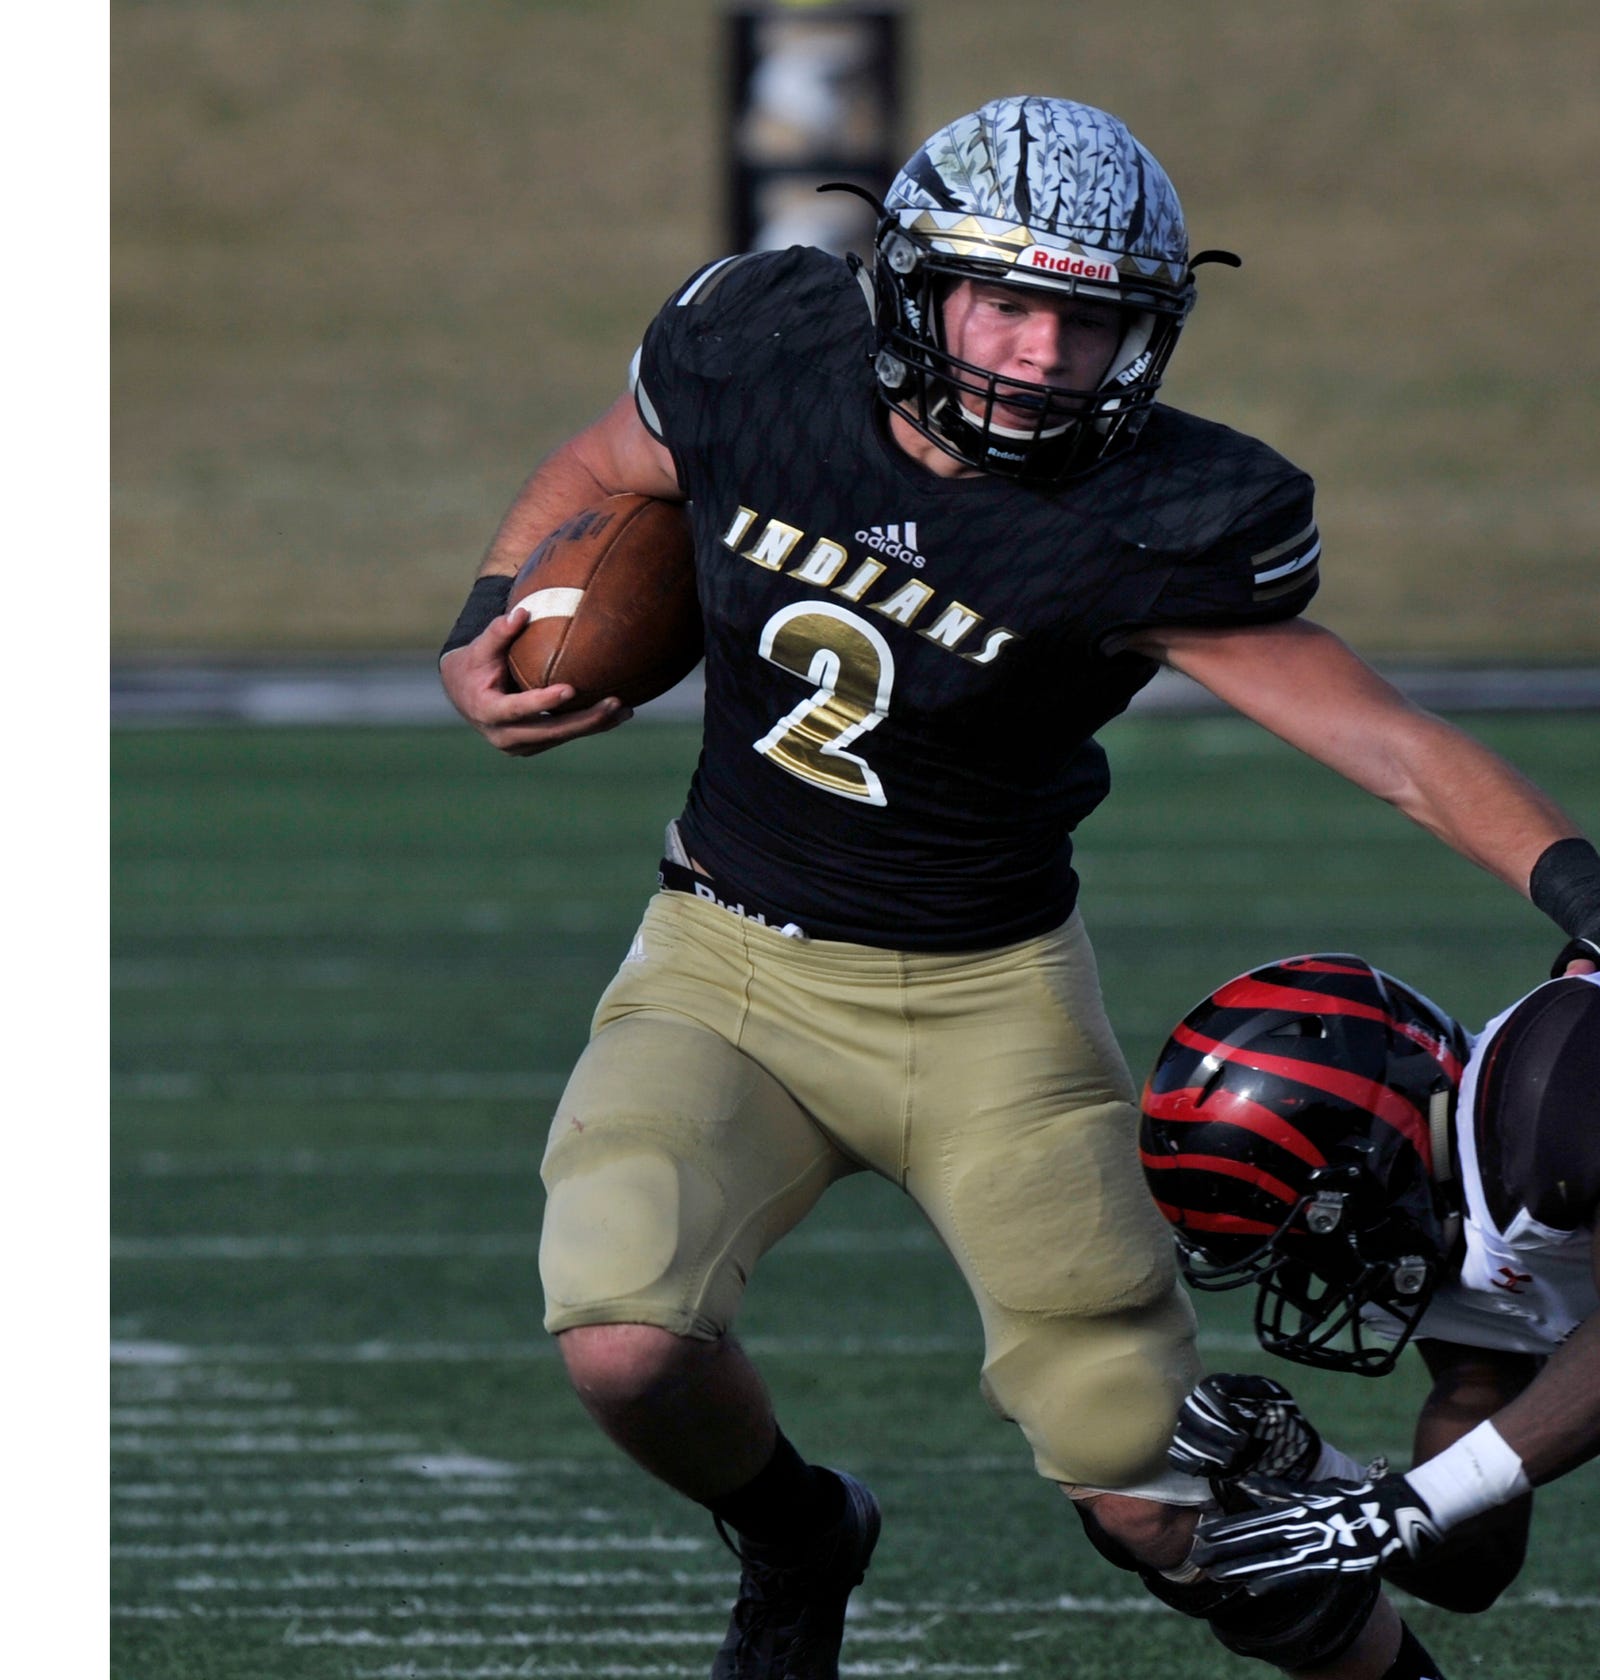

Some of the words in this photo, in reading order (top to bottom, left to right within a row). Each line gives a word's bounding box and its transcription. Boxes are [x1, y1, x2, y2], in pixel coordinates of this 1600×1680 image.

[1032, 250, 1112, 280] Riddell
[719, 505, 1024, 667] INDIANS
[854, 529, 927, 569] adidas
[753, 600, 895, 807] 2
